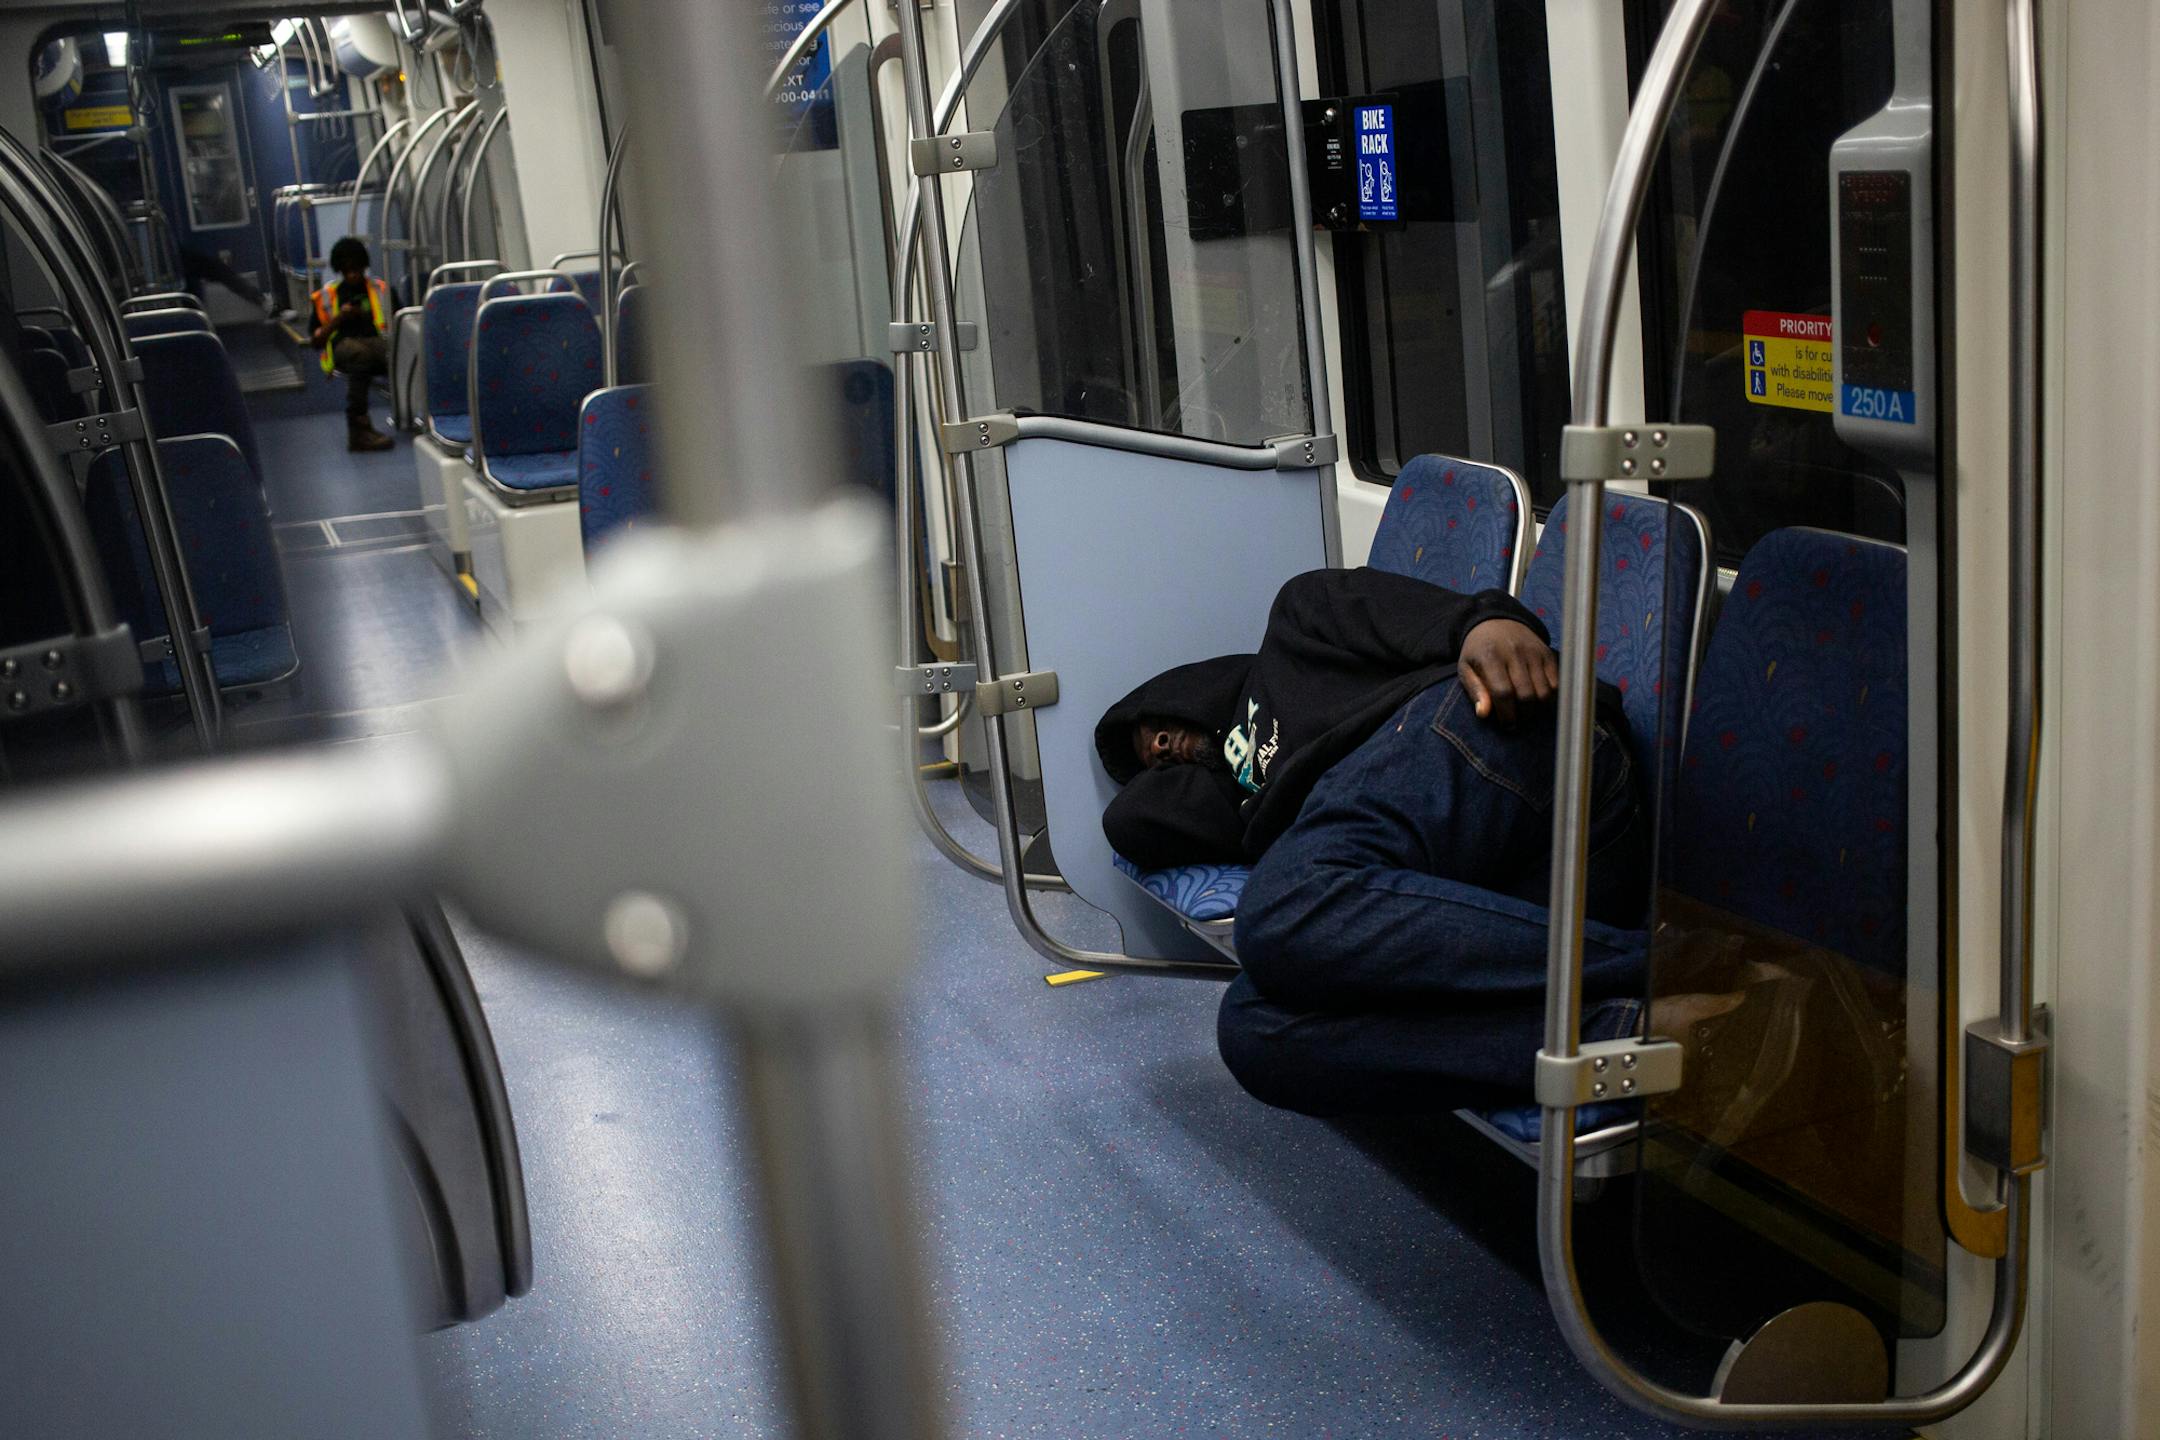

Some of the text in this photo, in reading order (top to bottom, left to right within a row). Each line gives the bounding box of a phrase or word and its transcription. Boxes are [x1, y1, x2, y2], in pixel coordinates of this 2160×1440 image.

[782, 4, 795, 14] or
[799, 2, 820, 13] see
[783, 74, 804, 87] XT
[1362, 109, 1385, 130] BIKE
[1362, 133, 1389, 154] RACK
[1780, 319, 1832, 336] PRIORITY
[1795, 345, 1803, 360] is
[1805, 346, 1818, 360] for
[1770, 363, 1790, 378] with
[1776, 382, 1834, 403] Please move
